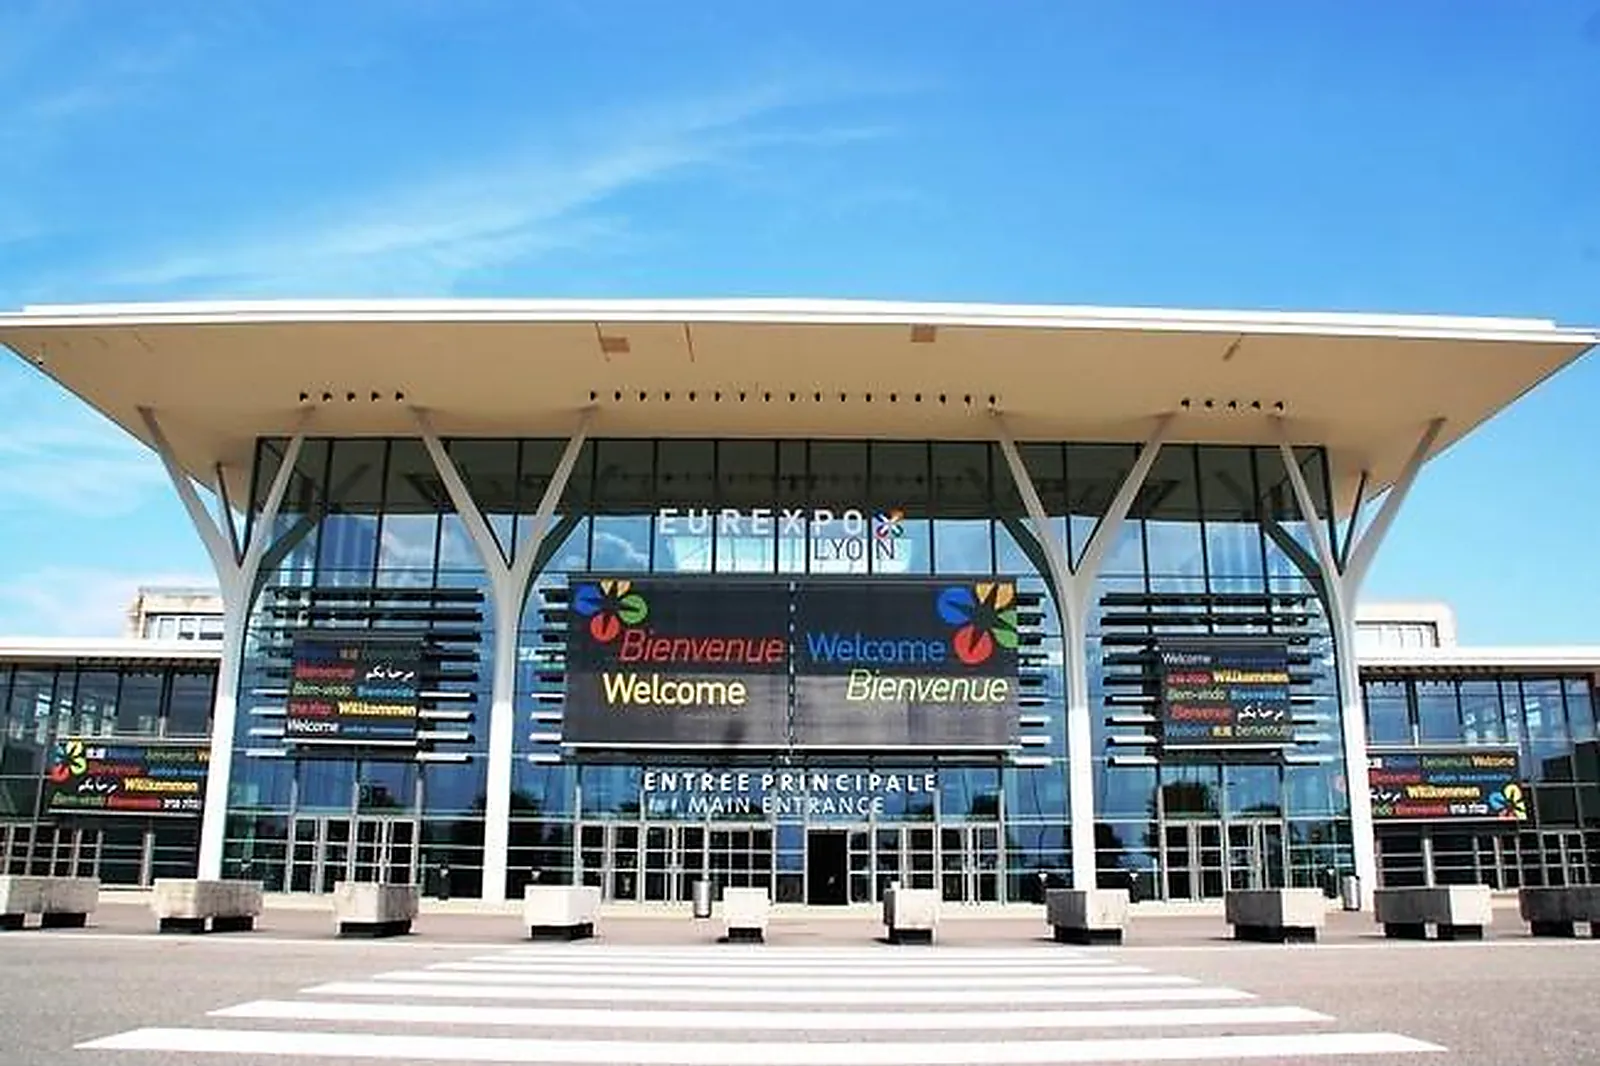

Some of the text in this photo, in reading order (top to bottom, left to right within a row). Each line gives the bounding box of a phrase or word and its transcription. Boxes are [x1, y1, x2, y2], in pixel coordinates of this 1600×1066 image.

[659, 508, 864, 535] EUREXPO
[814, 536, 896, 560] LYON
[619, 629, 785, 663] Bienvenue
[807, 632, 946, 662] Welcome
[603, 672, 748, 706] Welcome
[845, 668, 1009, 703] Bienvenue
[644, 772, 937, 793] ENTREE PRINCIPALE
[687, 796, 885, 815] MAIN ENTRANCE
